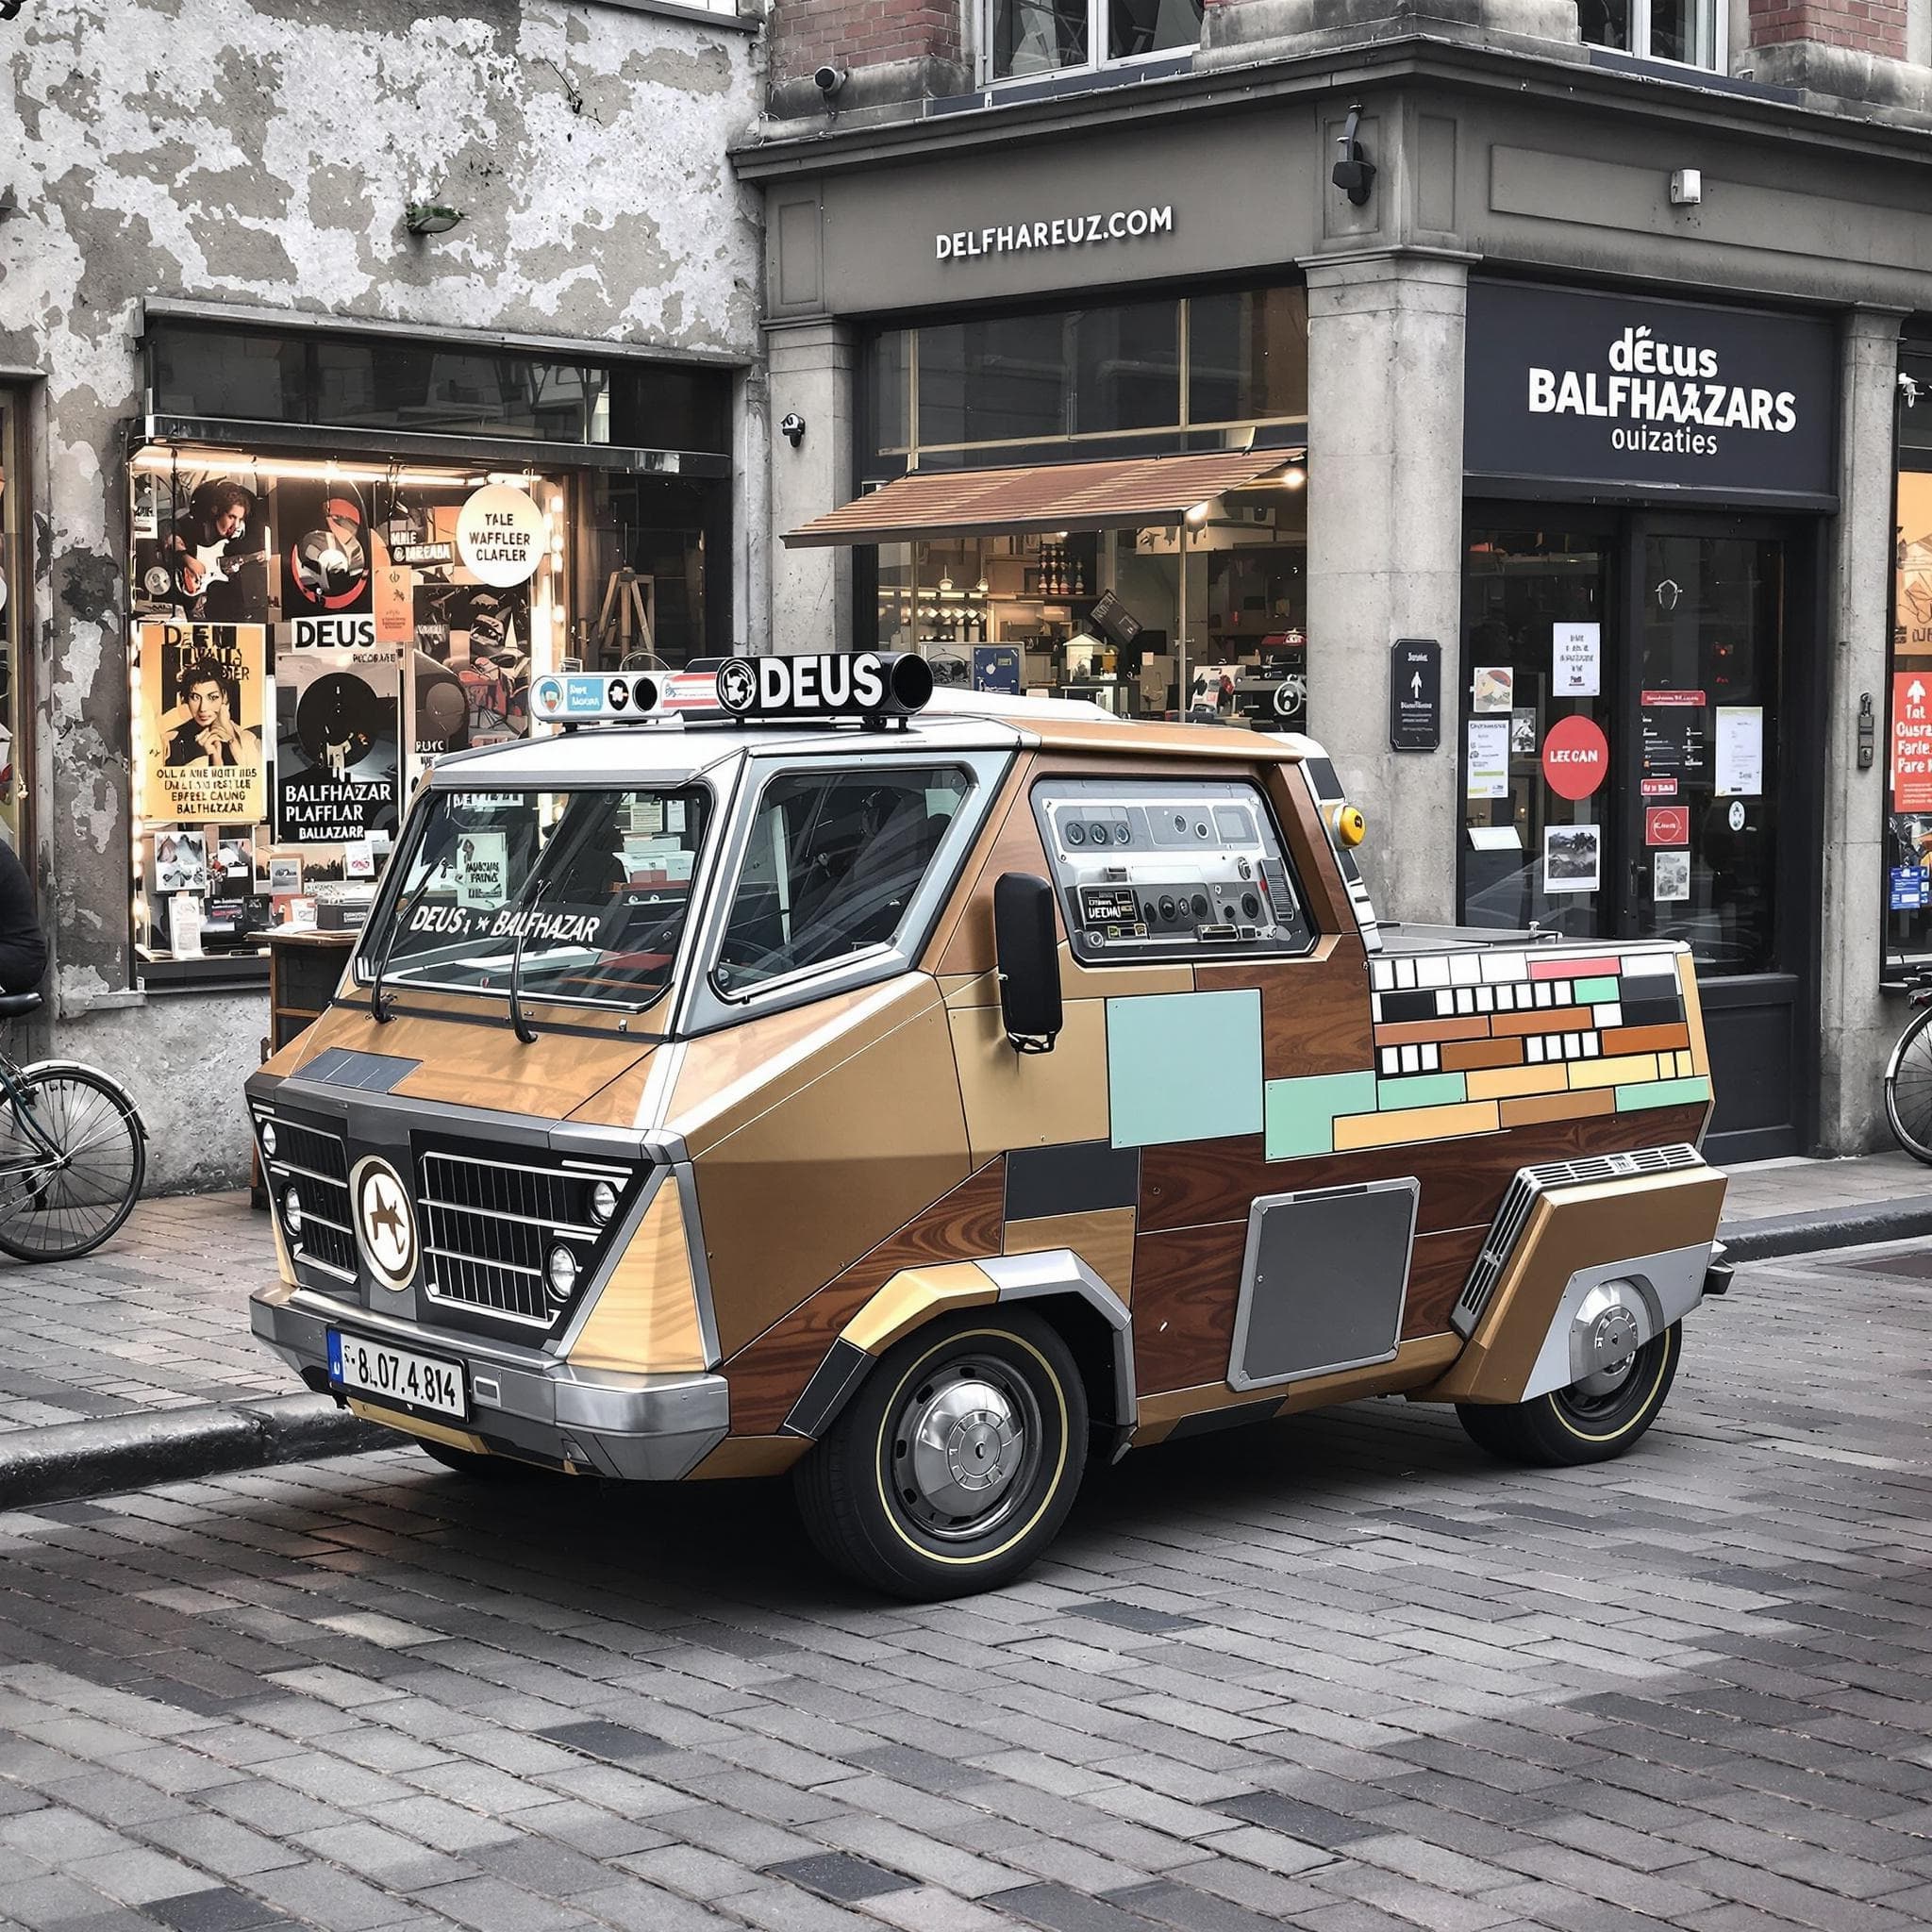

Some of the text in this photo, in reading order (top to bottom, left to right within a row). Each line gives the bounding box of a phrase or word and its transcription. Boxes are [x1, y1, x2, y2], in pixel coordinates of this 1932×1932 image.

[936, 205, 1173, 259] DELFHAREUZ.COM
[1611, 425, 1718, 455] ouizaties
[295, 620, 375, 649] DEUS
[759, 653, 883, 709] DEUS
[286, 804, 363, 823] PLAFFLAR
